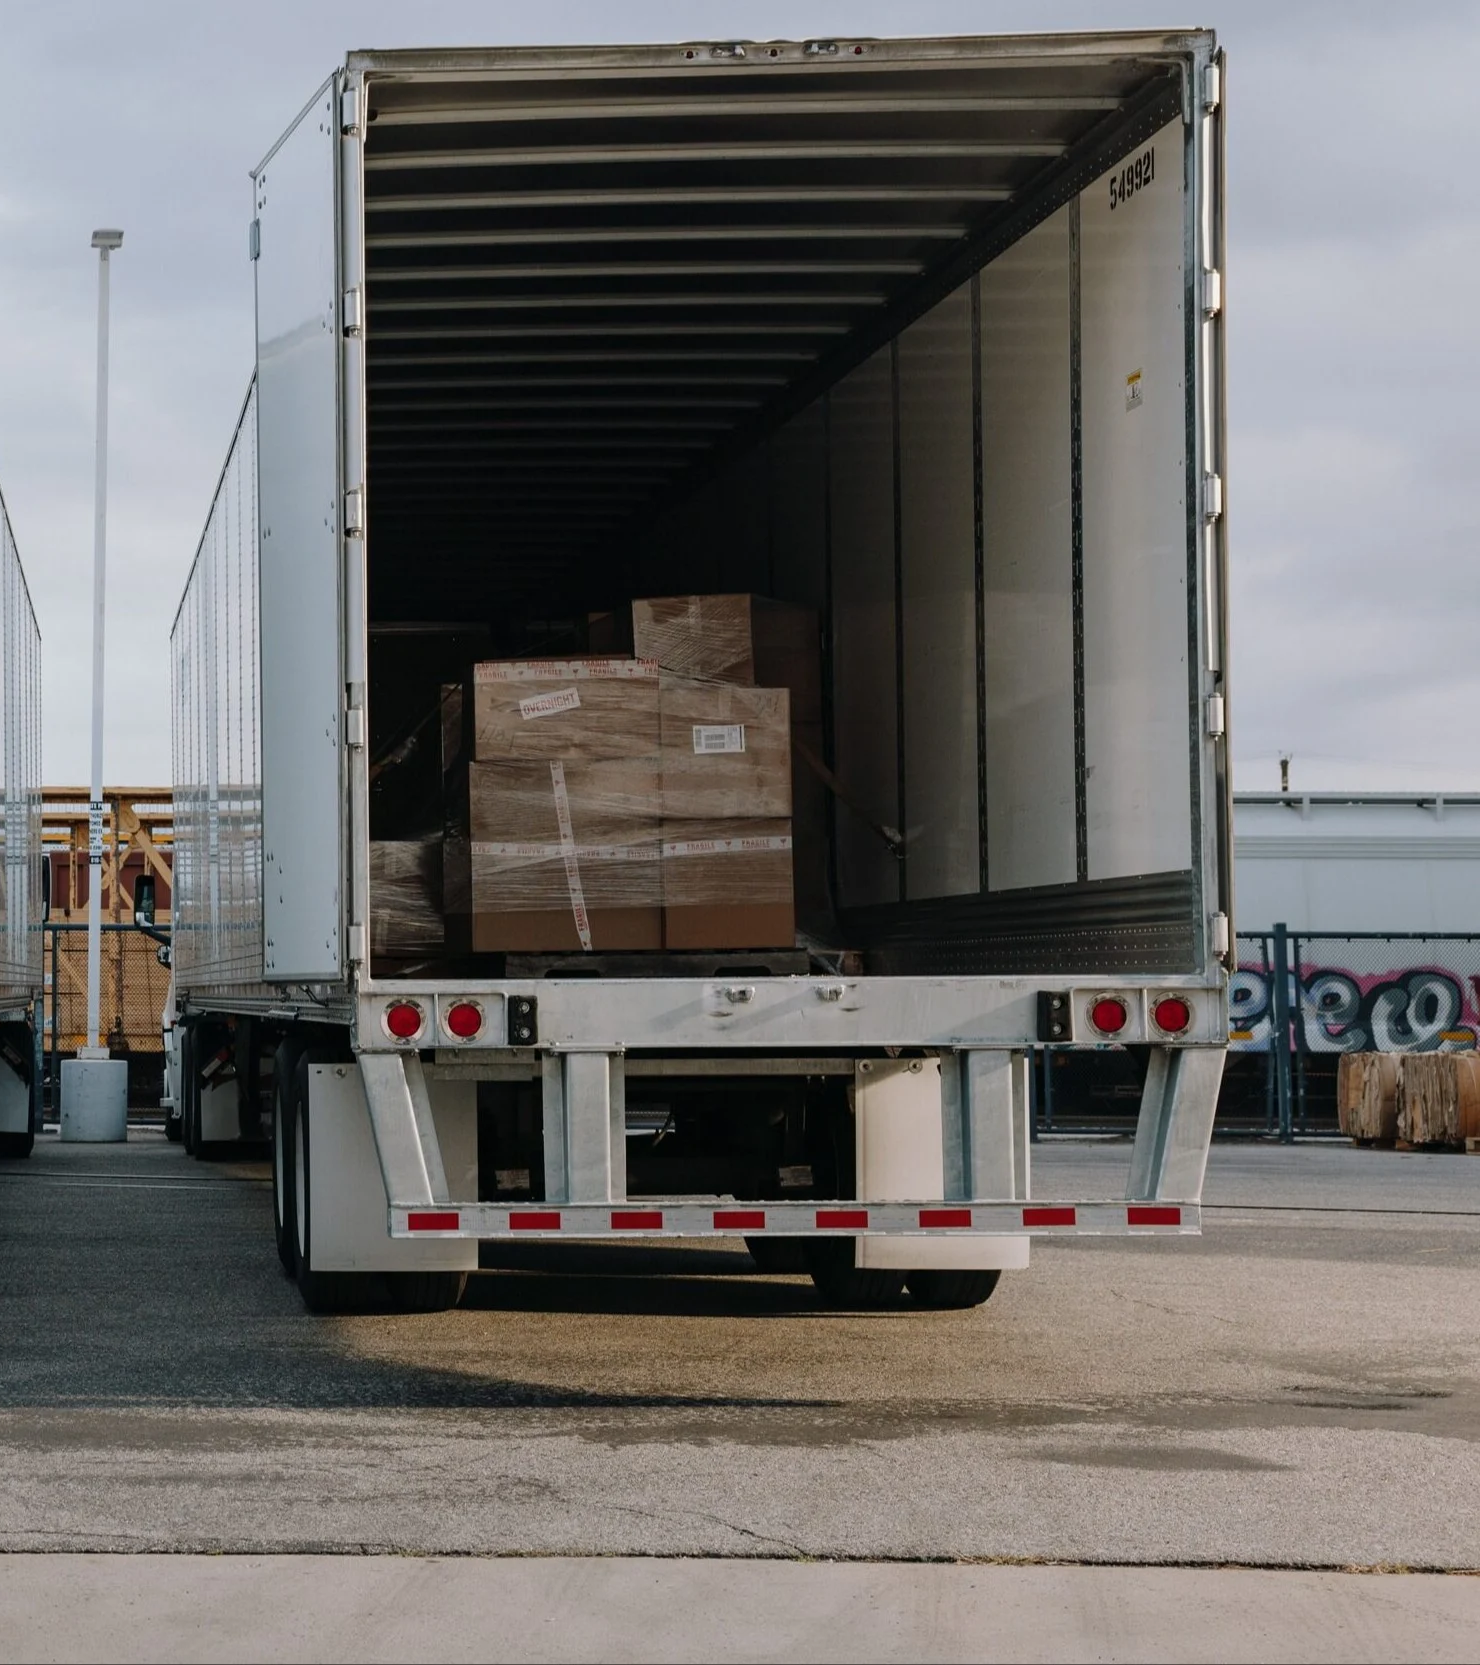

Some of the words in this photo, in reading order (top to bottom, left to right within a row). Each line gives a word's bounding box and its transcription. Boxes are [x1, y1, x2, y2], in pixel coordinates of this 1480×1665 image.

[1109, 146, 1155, 211] 549921
[522, 693, 576, 716] OVERNIGHT
[686, 841, 715, 851] FRAGILE
[741, 837, 771, 848] FRAGILE
